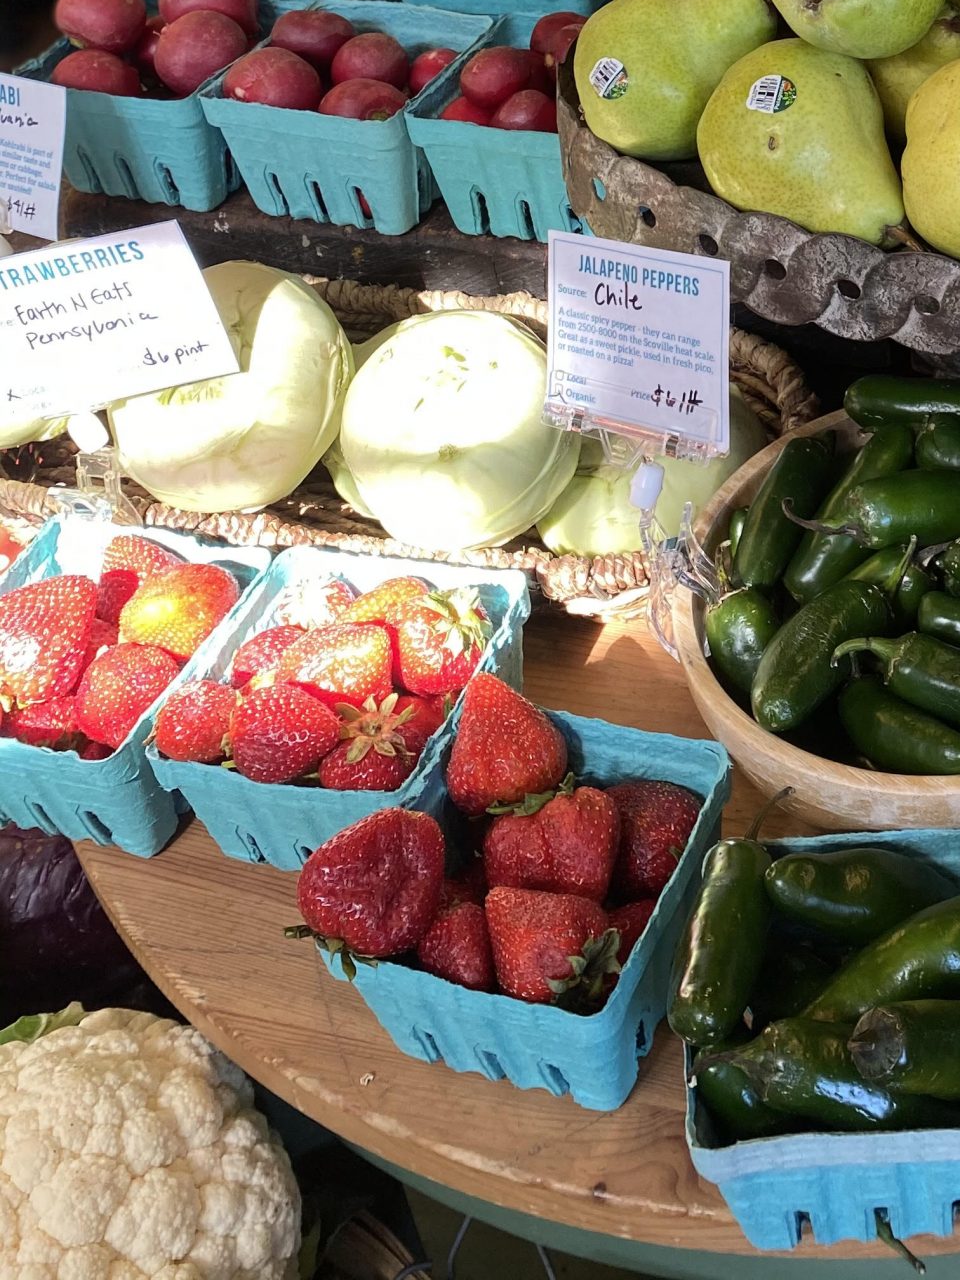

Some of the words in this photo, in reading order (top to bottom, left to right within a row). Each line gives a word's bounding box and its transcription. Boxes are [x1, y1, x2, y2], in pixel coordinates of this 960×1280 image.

[578, 254, 638, 284] JALAPENO
[642, 268, 700, 297] PEPPERS
[14, 300, 67, 326] Earth
[71, 292, 89, 312] N
[90, 281, 133, 305] Eats
[558, 283, 587, 298] Source:
[594, 281, 643, 311] Chile
[558, 318, 576, 329] from
[629, 333, 642, 346] the
[643, 337, 674, 353] Scoville
[675, 345, 693, 357] heat
[566, 308, 590, 321] classic
[591, 313, 610, 327] spicy
[611, 319, 636, 333] pepper
[642, 325, 660, 340] they
[661, 330, 676, 341] can
[677, 334, 701, 348] range
[558, 329, 578, 343] Great
[594, 339, 617, 352] sweet
[643, 347, 661, 361] used
[672, 355, 693, 370] fresh
[567, 343, 594, 358] roasted
[613, 354, 634, 368] pizza!
[565, 388, 597, 404] Organic
